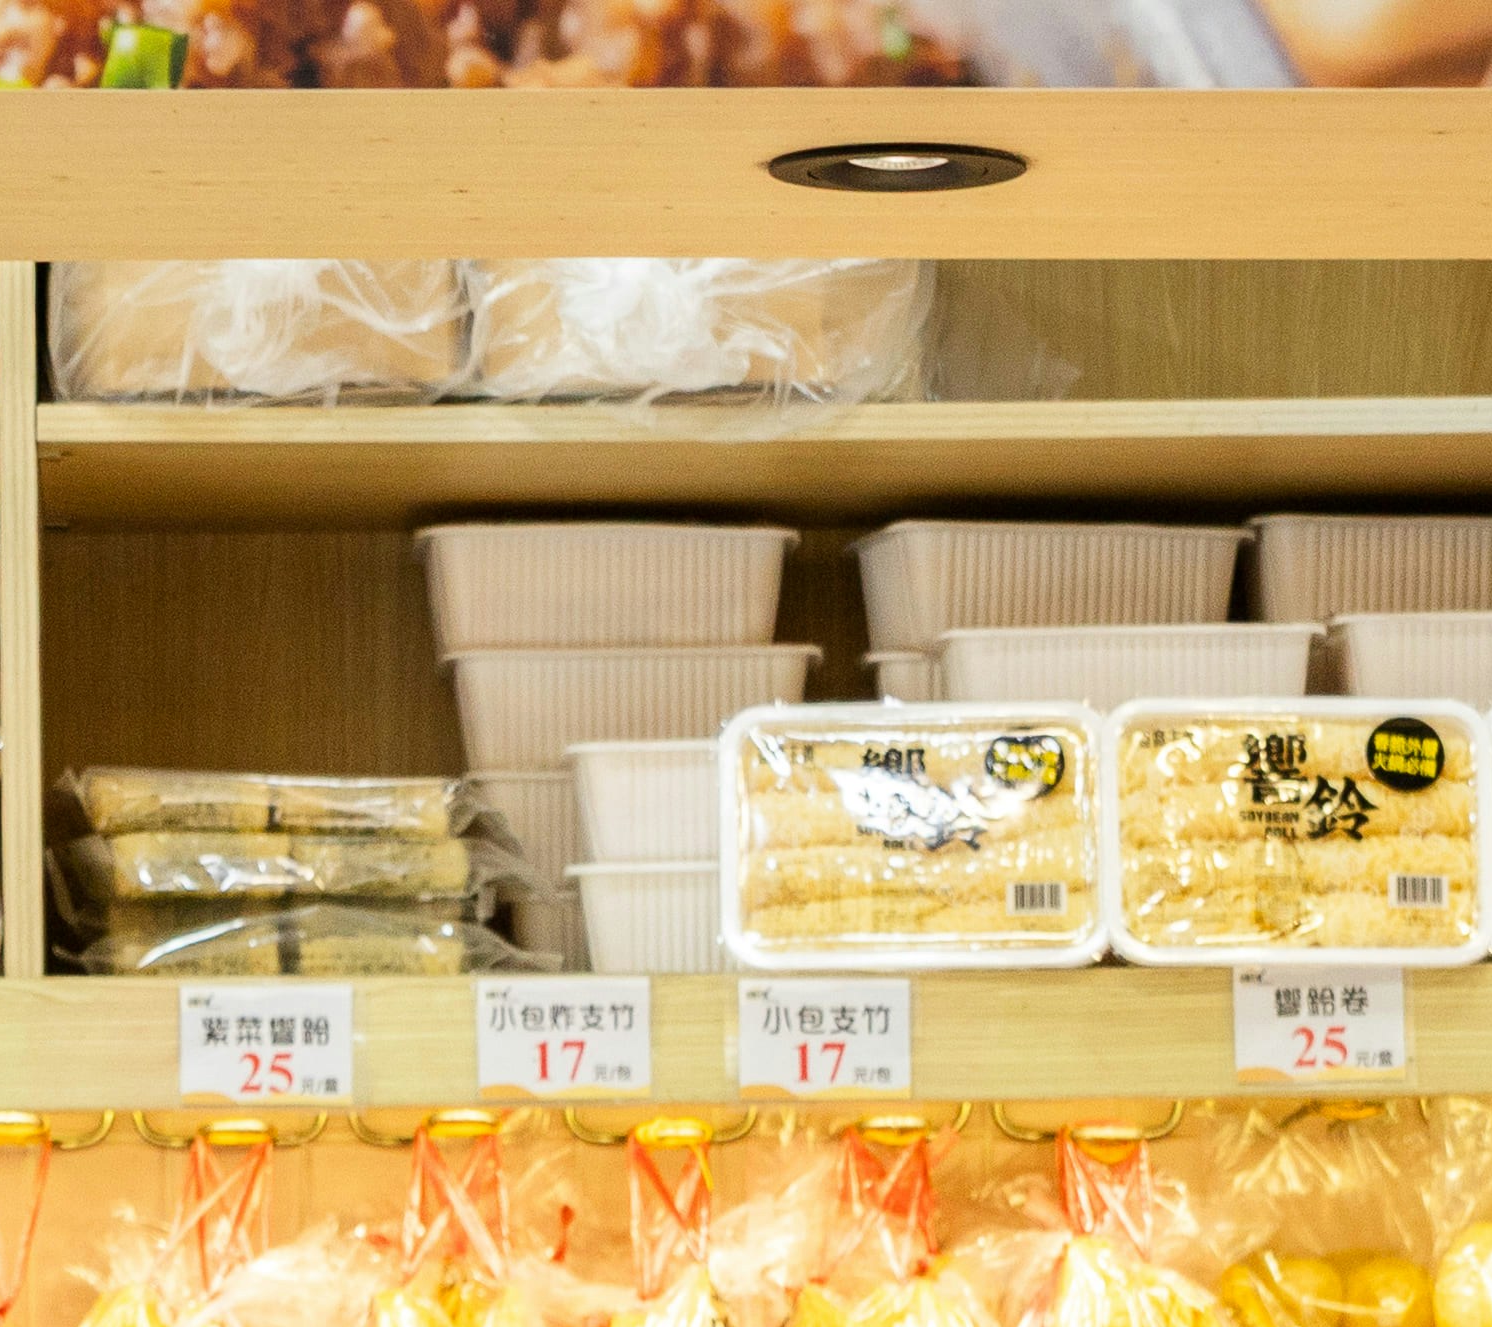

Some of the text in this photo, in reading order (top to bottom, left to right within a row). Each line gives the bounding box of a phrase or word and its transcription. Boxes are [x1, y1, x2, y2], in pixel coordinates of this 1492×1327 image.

[1239, 810, 1300, 824] SOYBEAN
[490, 1004, 634, 1032] 小包炸支竹
[763, 1006, 890, 1035] 小包支竹
[538, 1041, 586, 1082] 17
[797, 1042, 846, 1083] 17
[1293, 1026, 1349, 1069] 25
[240, 1052, 294, 1093] 25
